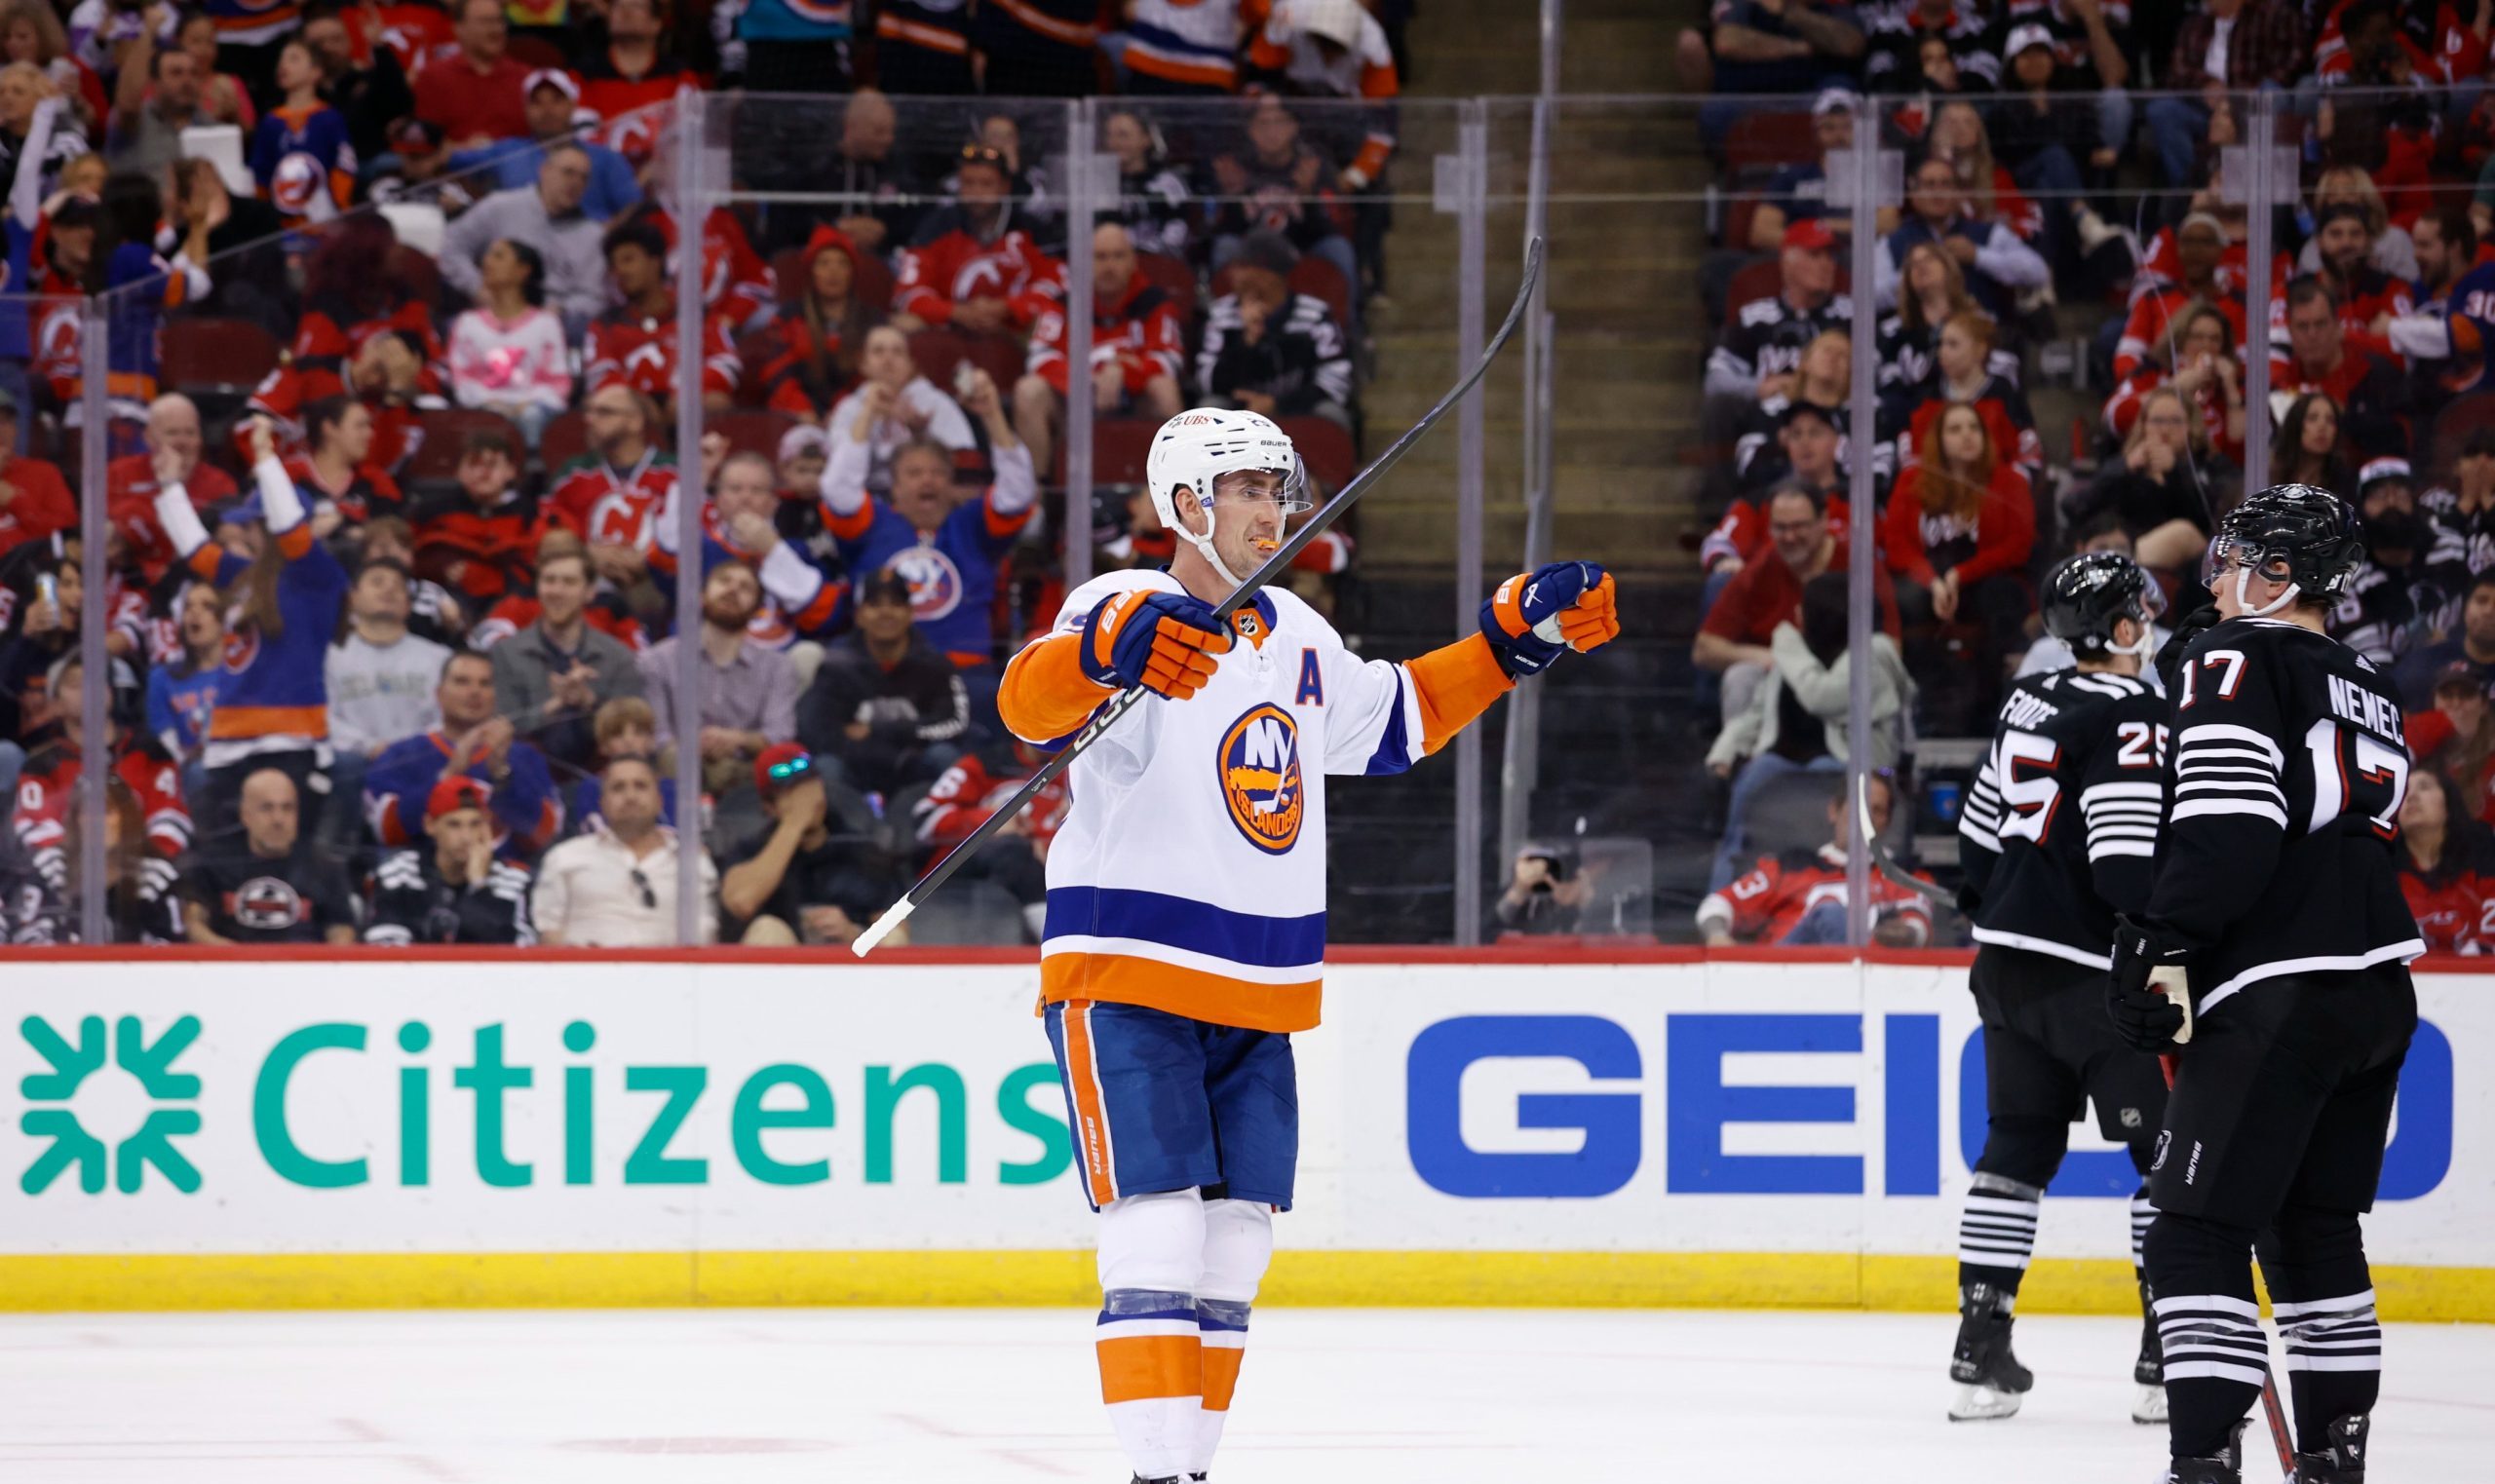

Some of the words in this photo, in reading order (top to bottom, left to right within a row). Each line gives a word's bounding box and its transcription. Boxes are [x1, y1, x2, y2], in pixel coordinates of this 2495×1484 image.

[1183, 415, 1210, 426] UBS
[1294, 647, 1324, 706] A
[2179, 649, 2249, 711] 17
[2327, 673, 2405, 747] NEMEC
[2116, 721, 2169, 769] 25
[2304, 716, 2410, 842] 17
[1235, 788, 1299, 837] ISLANDERS
[252, 1020, 1075, 1188] Citizens
[1407, 1013, 2453, 1200] GEI
[1085, 1116, 1101, 1175] BAUER
[2184, 1140, 2203, 1186] BAUER
